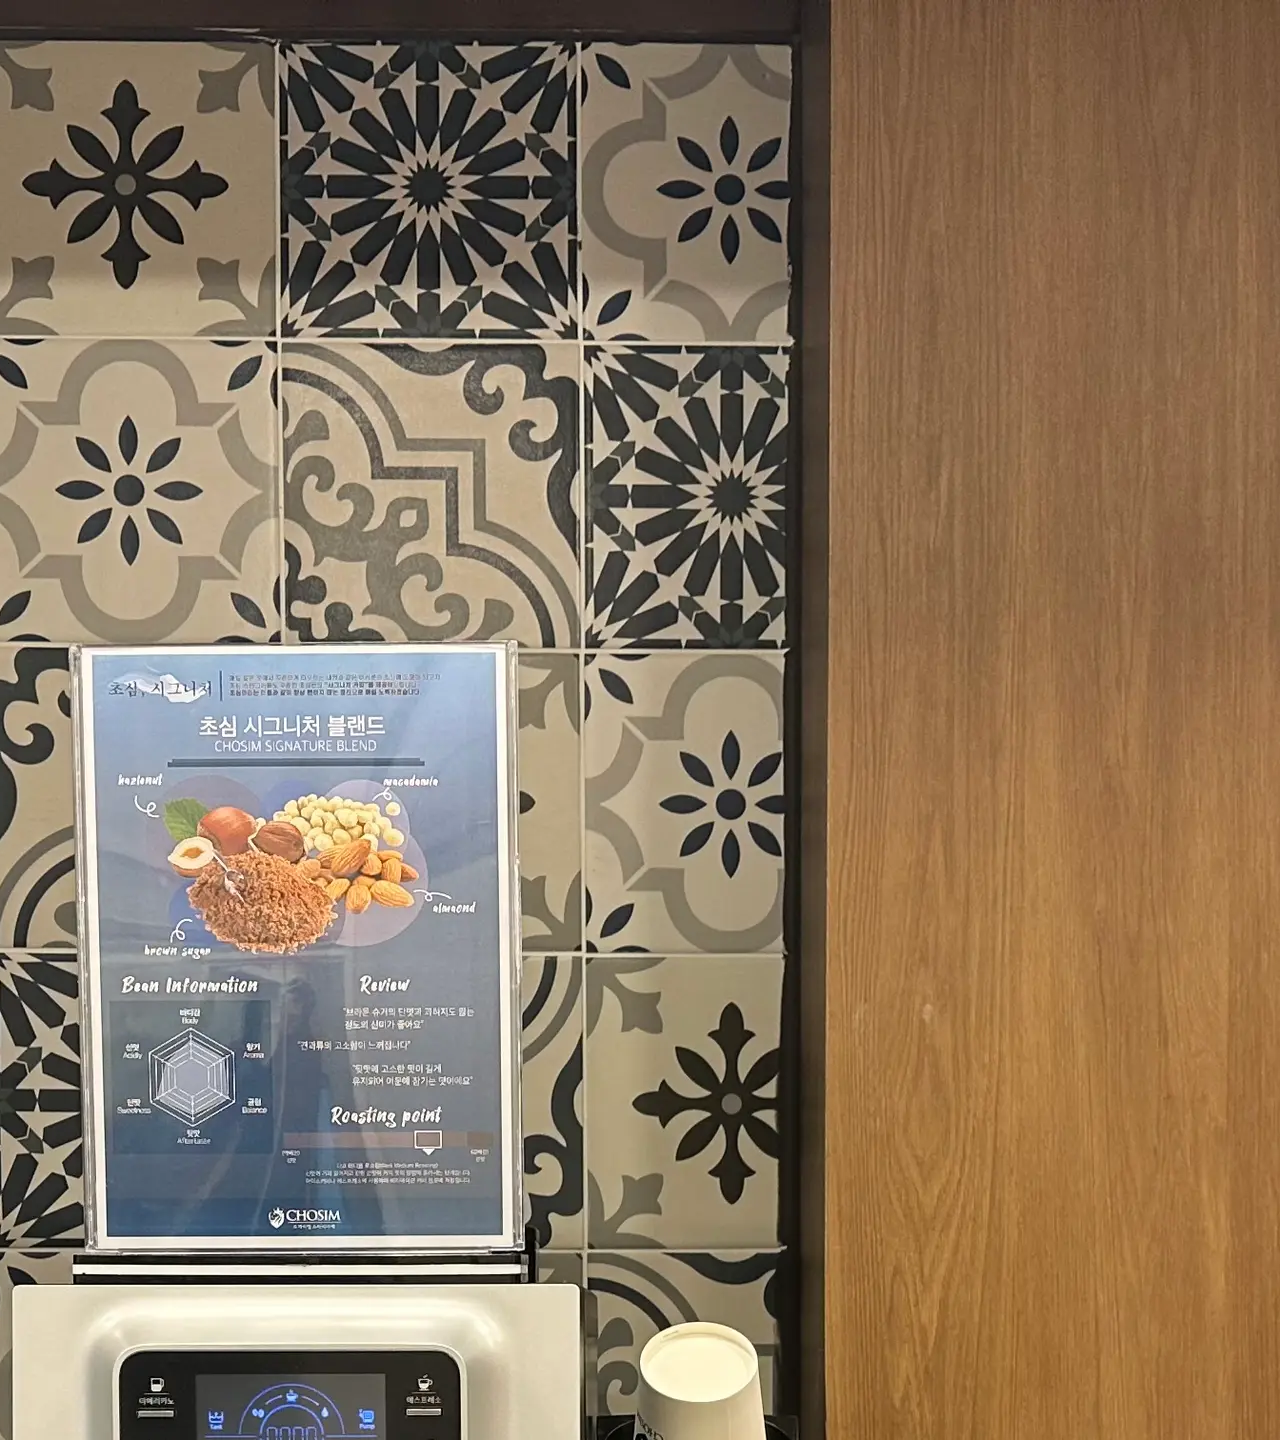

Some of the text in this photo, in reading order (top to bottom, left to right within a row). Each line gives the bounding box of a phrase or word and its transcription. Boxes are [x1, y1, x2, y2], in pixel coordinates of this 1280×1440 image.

[151, 681, 212, 697] 시그니처
[199, 715, 386, 738] 초심 시그니처 블랜드
[214, 739, 377, 752] CHOSIM SIGNATURE BLEND
[144, 944, 211, 960] brown sugar
[122, 976, 258, 994] Bean Information
[360, 975, 411, 995] Review
[331, 1106, 442, 1129] Roasting point
[286, 1210, 341, 1222] CHOSIM
[139, 1396, 175, 1405] 아메리카노
[406, 1395, 441, 1405] 에스프레소
